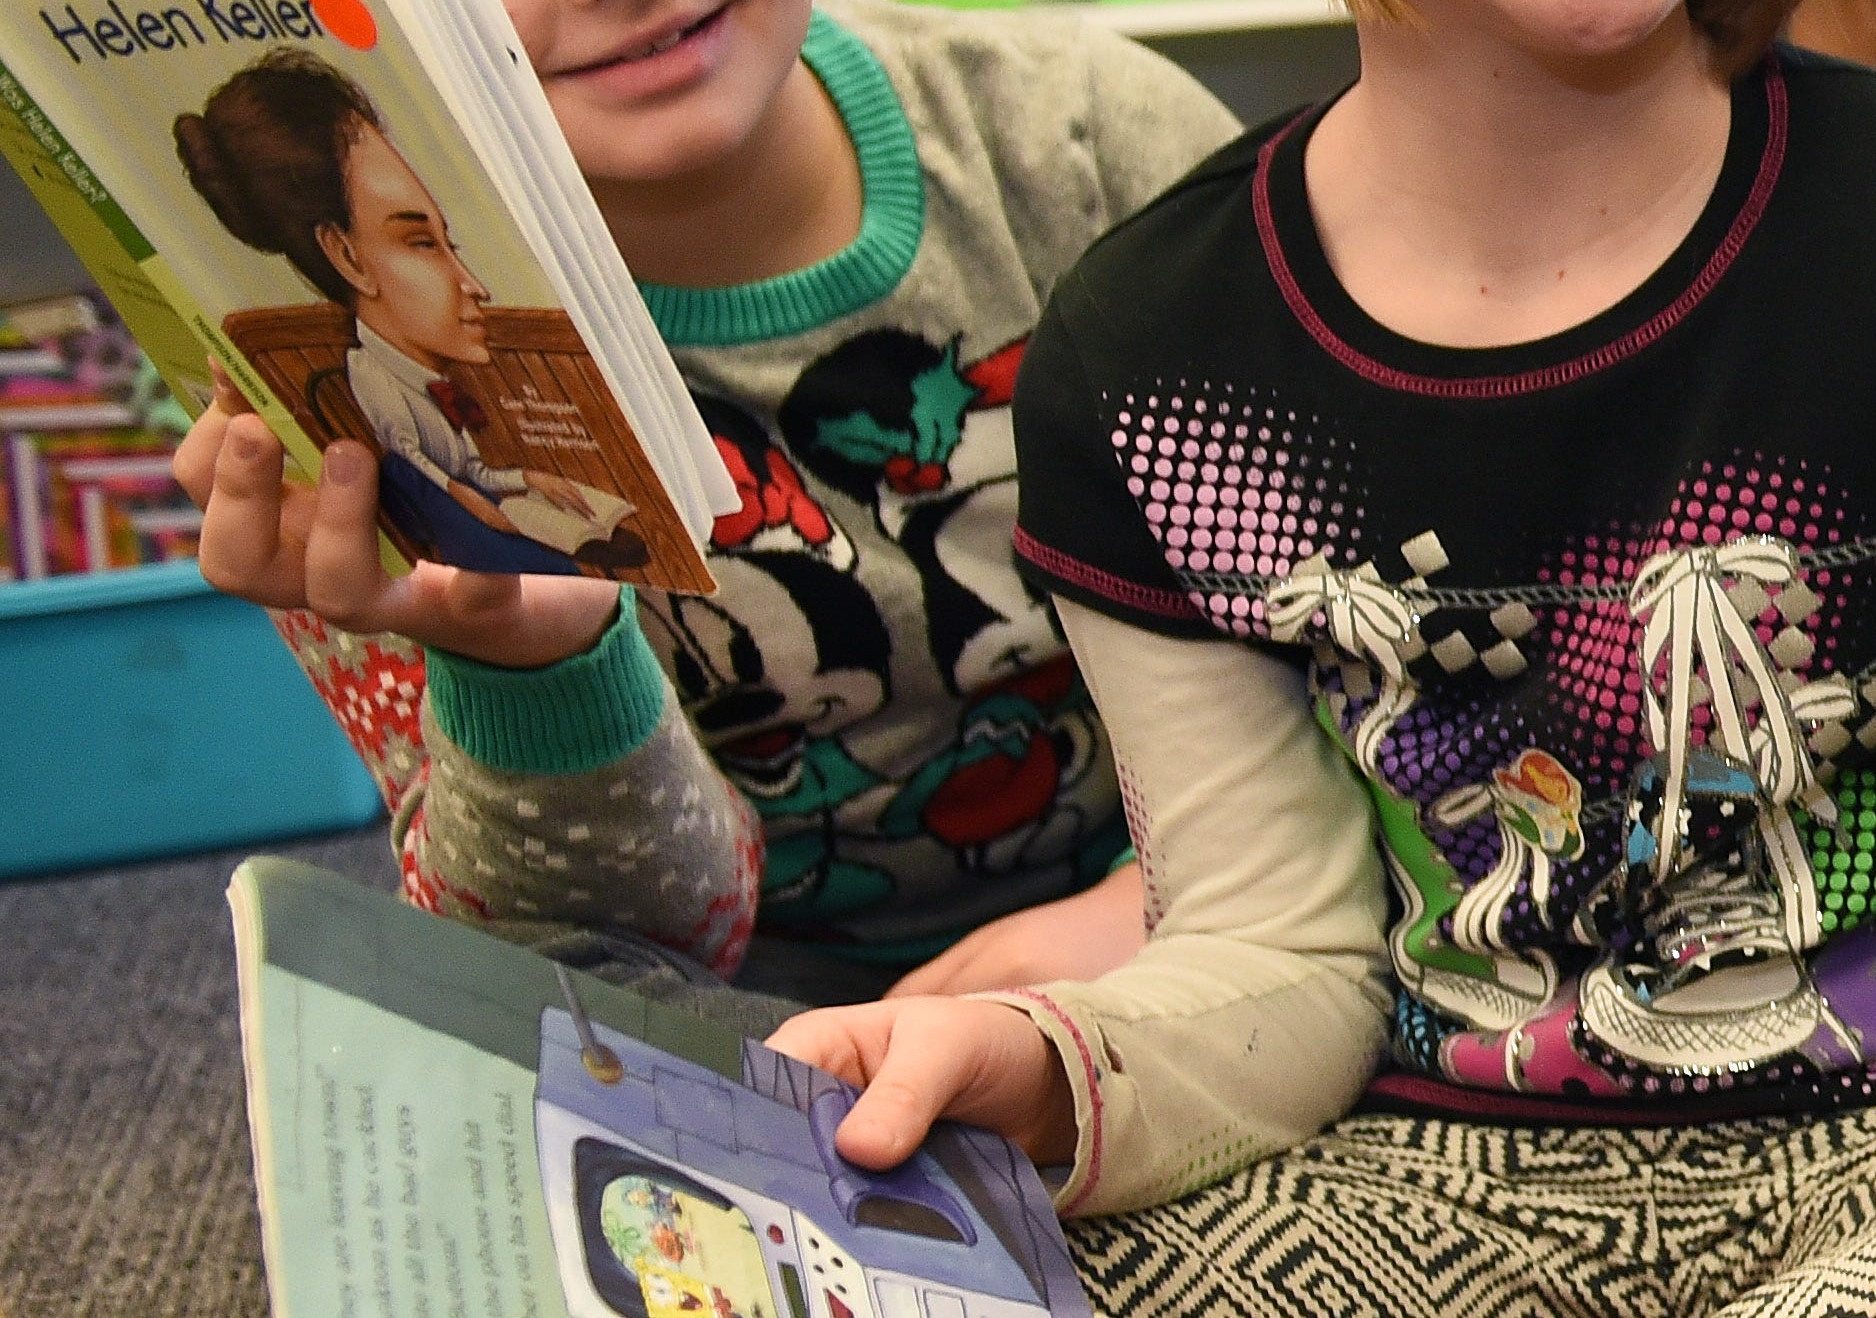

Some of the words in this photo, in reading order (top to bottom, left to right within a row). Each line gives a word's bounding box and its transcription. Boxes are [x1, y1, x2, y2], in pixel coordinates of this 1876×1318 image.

[463, 1119, 482, 1151] hit
[394, 1161, 417, 1205] bad
[464, 1155, 486, 1200] and
[497, 1138, 523, 1207] speed
[403, 1213, 421, 1250] the
[474, 1206, 500, 1277] phone
[509, 1214, 526, 1246] his
[514, 1253, 531, 1281] on
[484, 1281, 502, 1318] the
